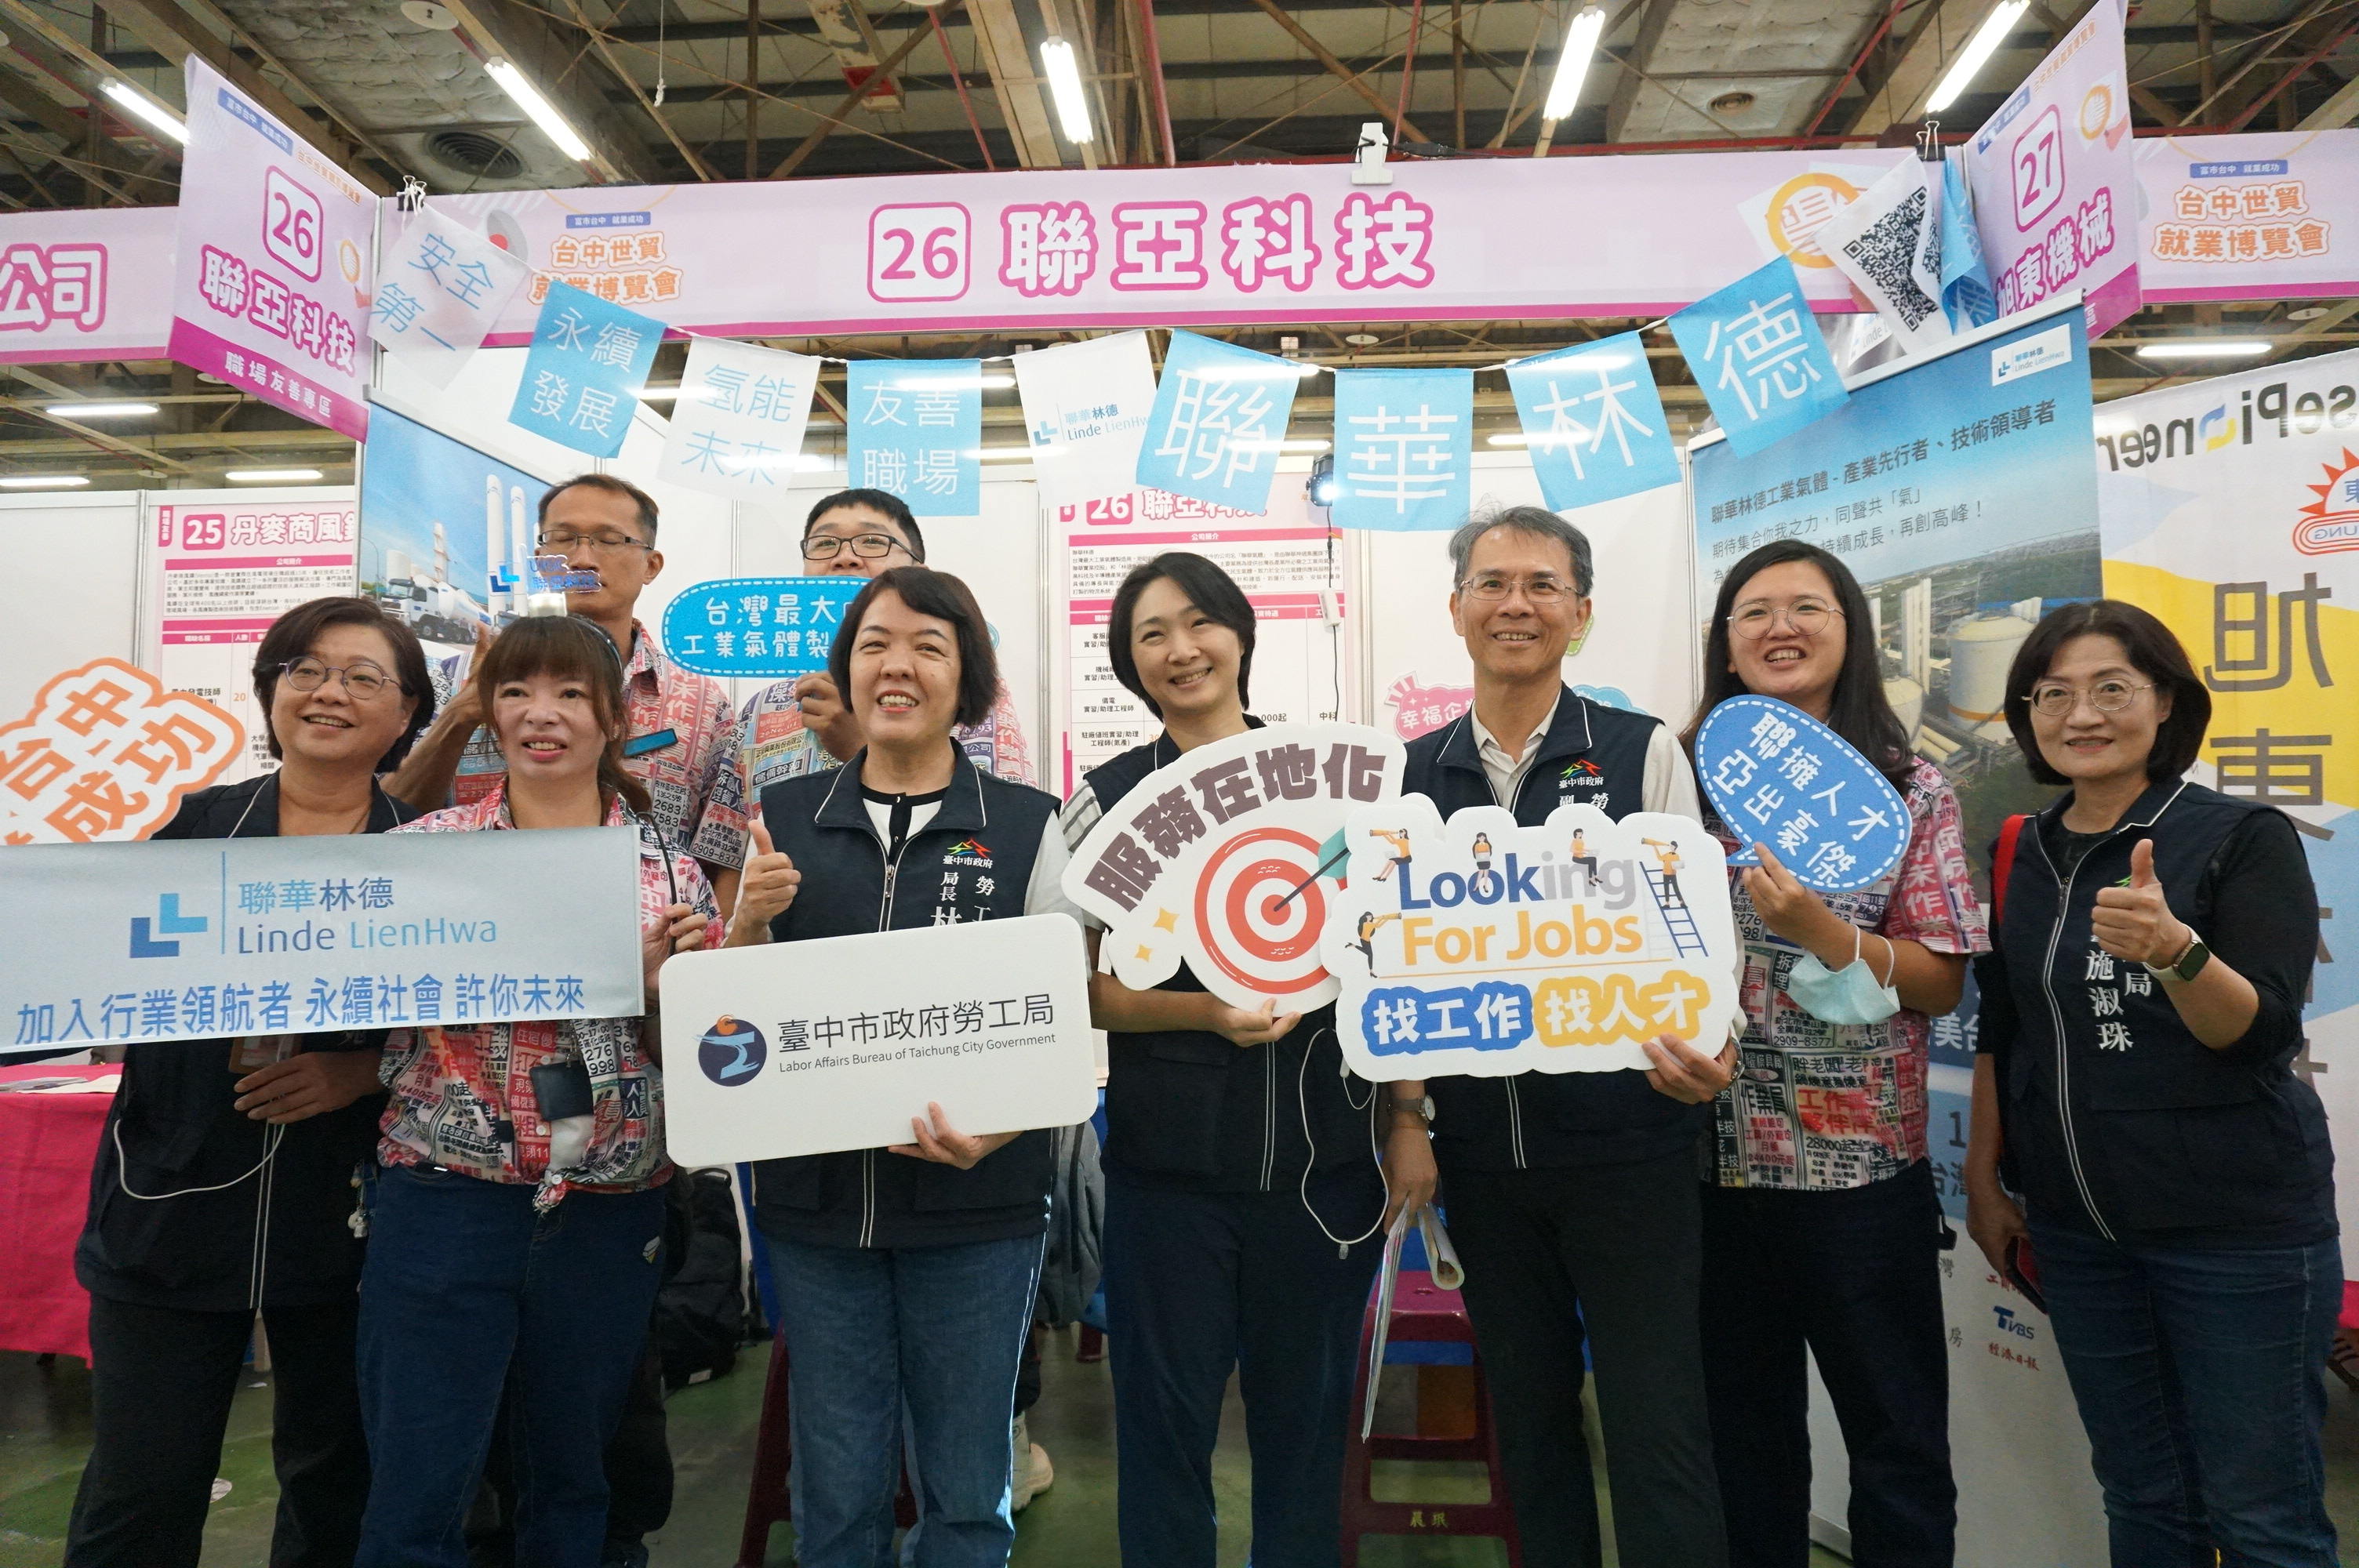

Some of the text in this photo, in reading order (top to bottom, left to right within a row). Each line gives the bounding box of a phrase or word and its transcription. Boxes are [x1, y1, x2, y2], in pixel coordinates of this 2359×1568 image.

[2022, 132, 2054, 209] 27
[2201, 162, 2280, 175] 富市台中 就業成功
[574, 215, 644, 226] 富市台中 就業成功
[2175, 184, 2306, 218] 台中世貿
[272, 192, 314, 260] 26
[881, 194, 1432, 295] 26 聯亞科技
[2156, 223, 2328, 261] 就業博覽會
[554, 234, 664, 265] 台中世貿
[0, 244, 107, 332] 公司
[408, 233, 494, 310] 安全
[202, 248, 356, 376] 聯亞科技
[372, 282, 456, 351] 第一
[547, 307, 643, 373] 永續
[2015, 350, 2065, 372] Linde LienHwa
[224, 353, 333, 418] 職場友善專區
[530, 370, 617, 438] 發展
[862, 379, 961, 429] 友善
[1154, 292, 1822, 514] 聯 華 林 德
[1065, 404, 1119, 424] 聯華林德
[1068, 416, 1151, 440] Linde LienHw
[681, 430, 783, 486] 未來
[864, 448, 959, 495] 職場
[1710, 470, 1829, 524] 聯華林德工業氣體
[1844, 397, 2056, 486] 產業先行者、技術領導者
[1090, 493, 1129, 520] 26
[185, 518, 222, 545] 25
[1191, 532, 1219, 541] 公司簡介
[276, 557, 302, 566] 公司簡介
[706, 593, 836, 627] 台灣最大
[681, 629, 829, 659] 工業氣體製
[234, 693, 246, 702] 20
[0, 677, 134, 802] 台中
[4, 713, 216, 846] 成功
[1558, 776, 1605, 789] 臺中市政府
[1750, 711, 1890, 841] 聯擁人才
[652, 811, 679, 827] 7583
[653, 799, 682, 815] 2683
[1590, 792, 1610, 810] 勞
[1712, 749, 1857, 884] 亞出豪傑
[1083, 742, 1387, 913] 服務在地化
[692, 843, 742, 866] 2909-8377
[943, 855, 994, 869] 臺中市政府
[238, 877, 394, 916] 聯華林德
[940, 871, 960, 902] 局長
[1397, 851, 1637, 911] Looking
[238, 913, 497, 956] Linde LienHwa
[1402, 904, 1644, 966] For Jobs
[2085, 949, 2135, 1053] 施淑珠
[2124, 971, 2153, 997] 局
[16, 972, 586, 1046] 加入行業領航者 永續社會 許你未來
[778, 993, 1054, 1054] 臺中市政府勞工局
[1372, 992, 1523, 1046] 找工作
[1544, 982, 1699, 1040] 找人才
[780, 1033, 1056, 1073] Labor Affairs Bureau of Taichung City Government
[1773, 1036, 1832, 1047] 2909-8377
[1993, 1305, 2035, 1340] TVBS
[1988, 1341, 2041, 1372] 經濟日報
